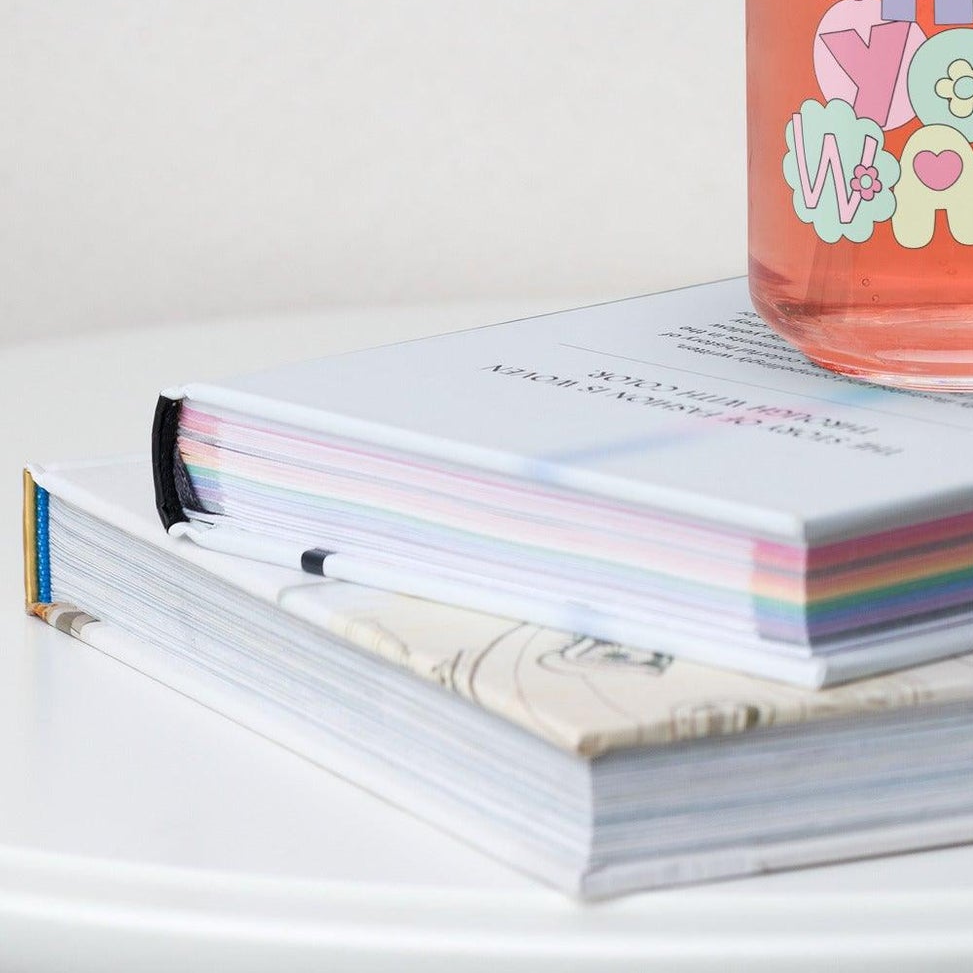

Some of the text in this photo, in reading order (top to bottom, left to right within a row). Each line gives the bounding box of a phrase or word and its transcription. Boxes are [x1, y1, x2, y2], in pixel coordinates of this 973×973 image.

[483, 365, 581, 387] WOVEN
[586, 370, 879, 434] THROUGH WITH COLOR.
[611, 392, 725, 417] FASHION
